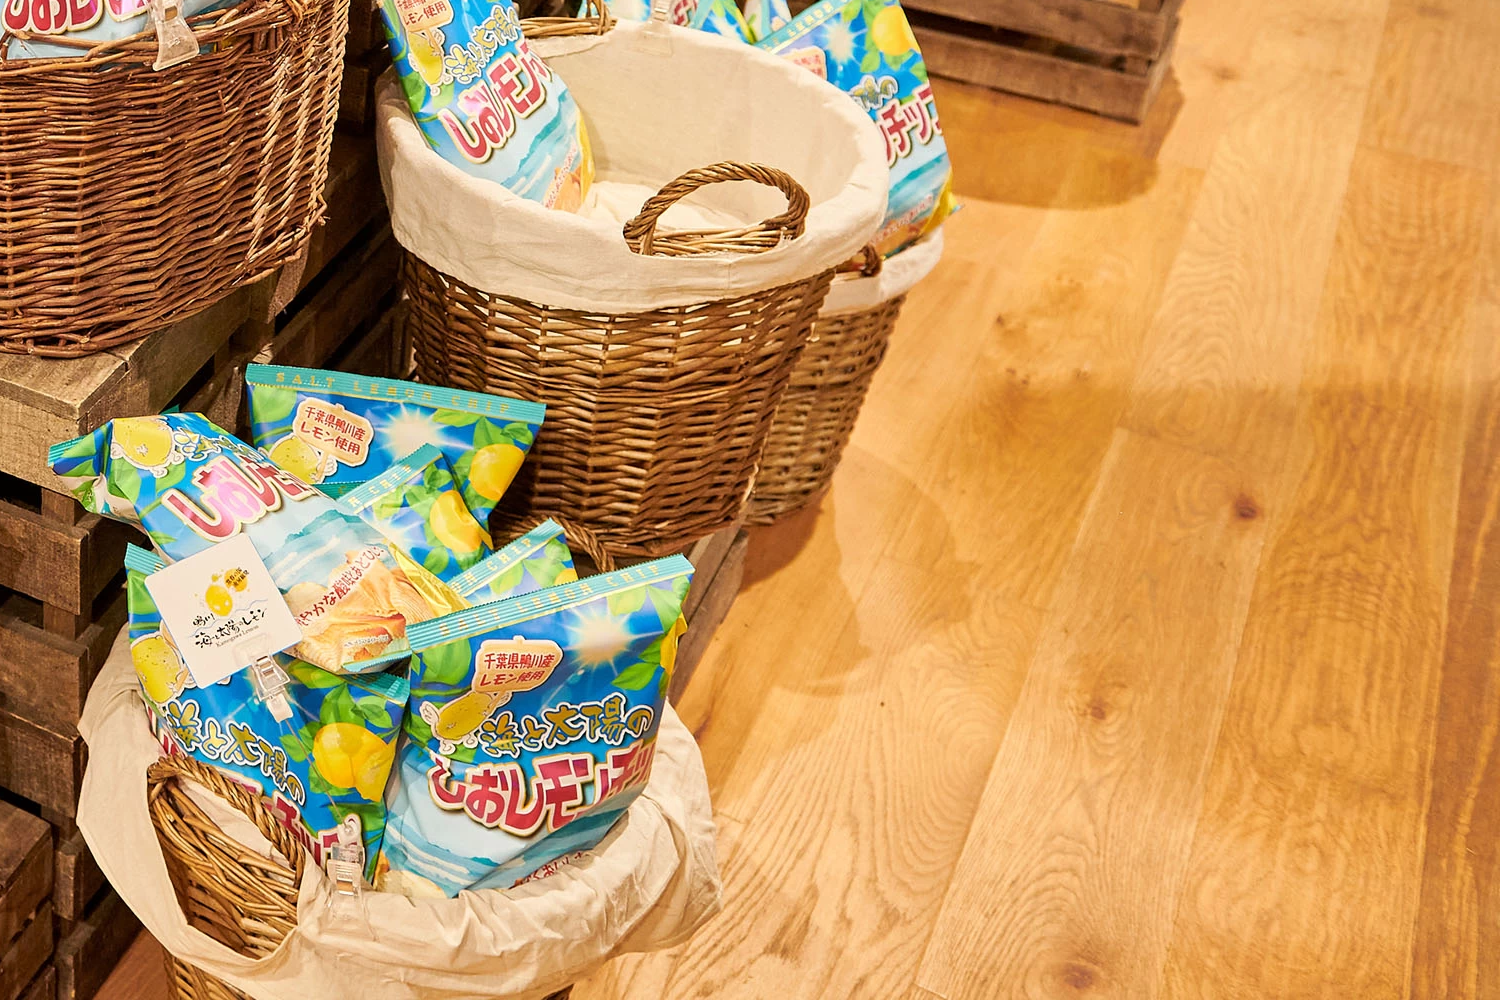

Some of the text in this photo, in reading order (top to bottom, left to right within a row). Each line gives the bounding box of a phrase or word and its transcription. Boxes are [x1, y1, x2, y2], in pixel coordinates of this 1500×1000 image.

[402, 1, 447, 26] レモン使用
[276, 371, 513, 413] SALT LEMON CHIP
[300, 421, 361, 456] レモン使用
[304, 404, 368, 443] 千葉県鴨川産
[438, 564, 663, 638] SALT LEMON CHIP
[479, 668, 545, 688] レモン使用
[483, 652, 556, 672] 千葉県鴨川産
[480, 693, 651, 757] 海と太陽の
[165, 699, 307, 807] 海と太陽の
